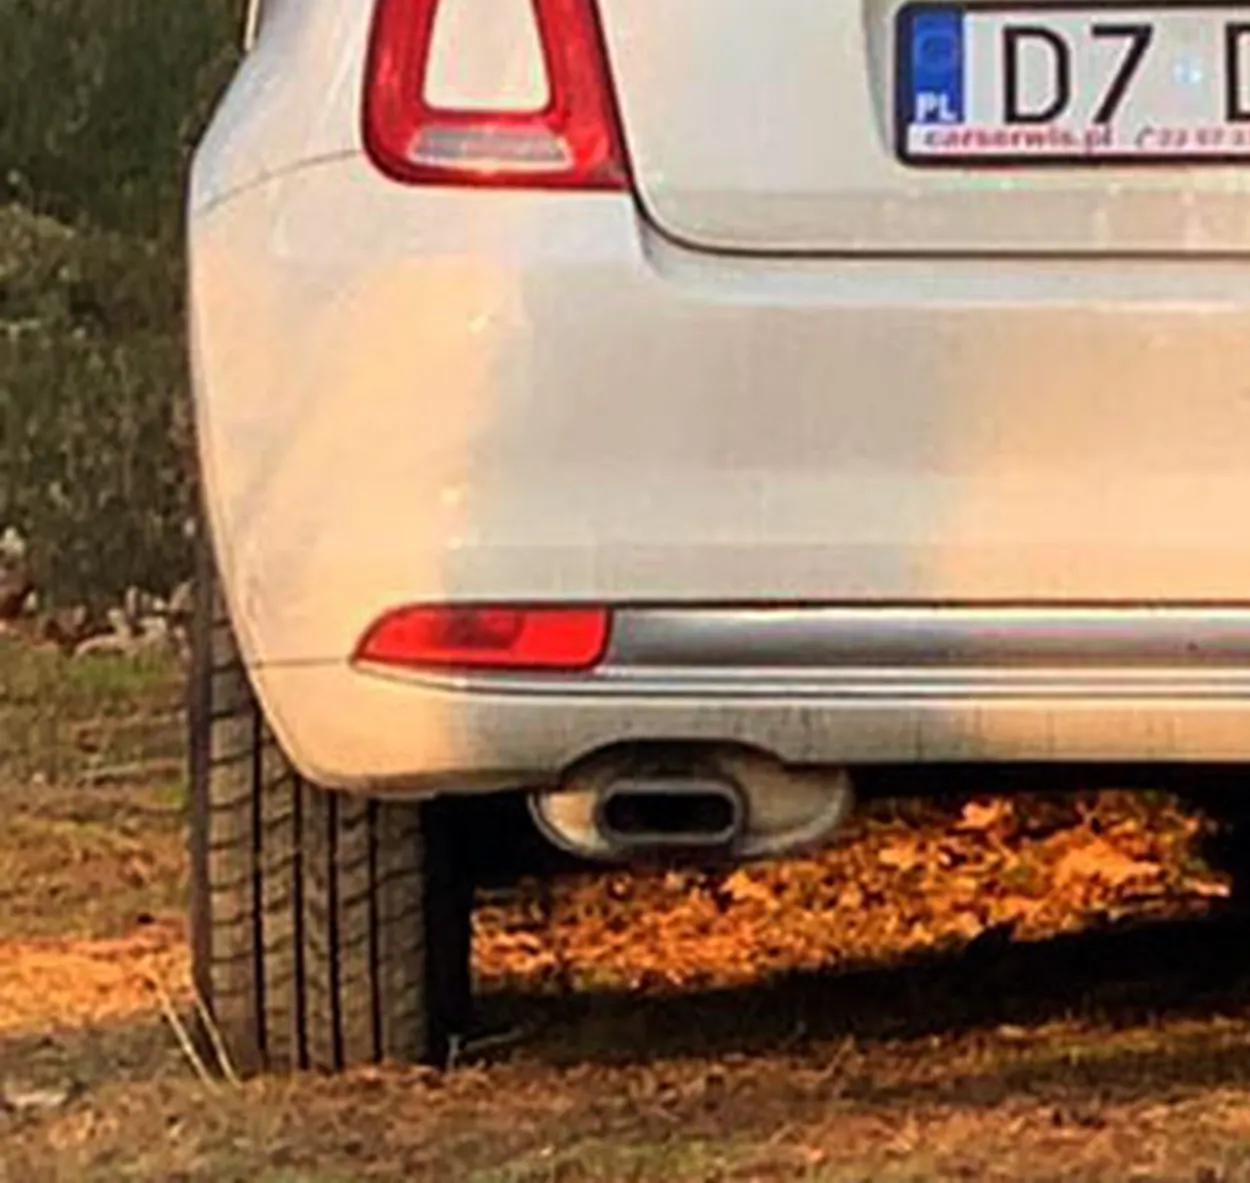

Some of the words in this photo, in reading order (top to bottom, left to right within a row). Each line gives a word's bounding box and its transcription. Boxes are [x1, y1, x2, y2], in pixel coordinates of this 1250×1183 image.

[1003, 25, 1153, 125] D7
[916, 91, 957, 122] PL
[923, 125, 1113, 152] carserwis.pl
